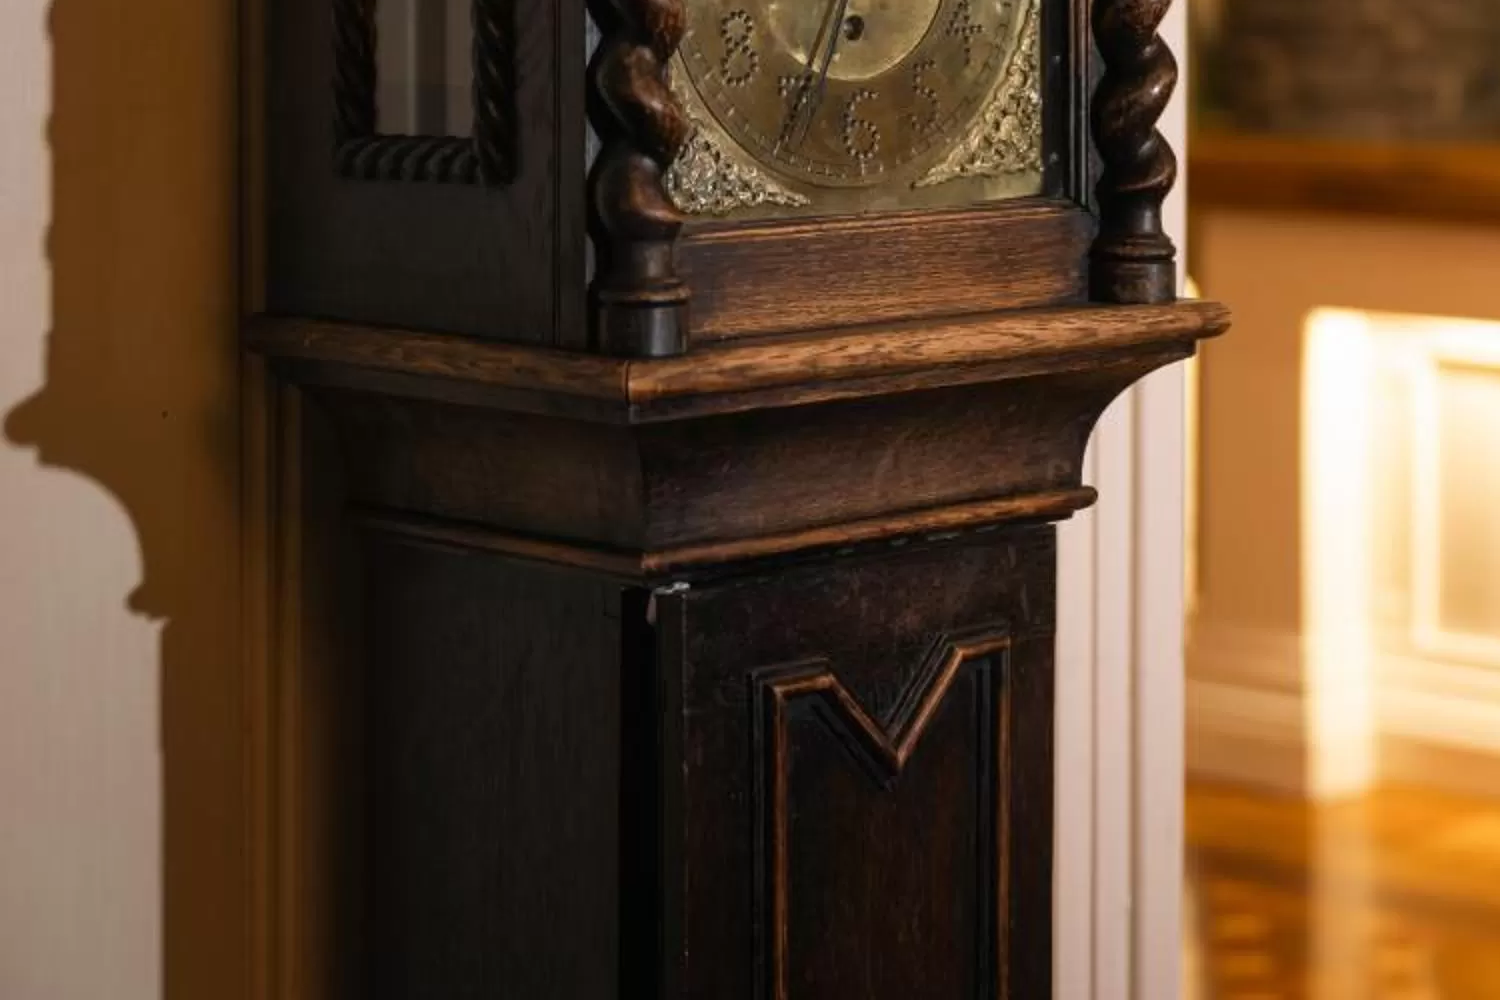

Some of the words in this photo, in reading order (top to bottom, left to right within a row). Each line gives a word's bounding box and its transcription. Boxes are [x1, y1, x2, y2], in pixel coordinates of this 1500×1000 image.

[721, 9, 758, 86] 8
[842, 88, 880, 160] 6
[911, 59, 938, 132] 5
